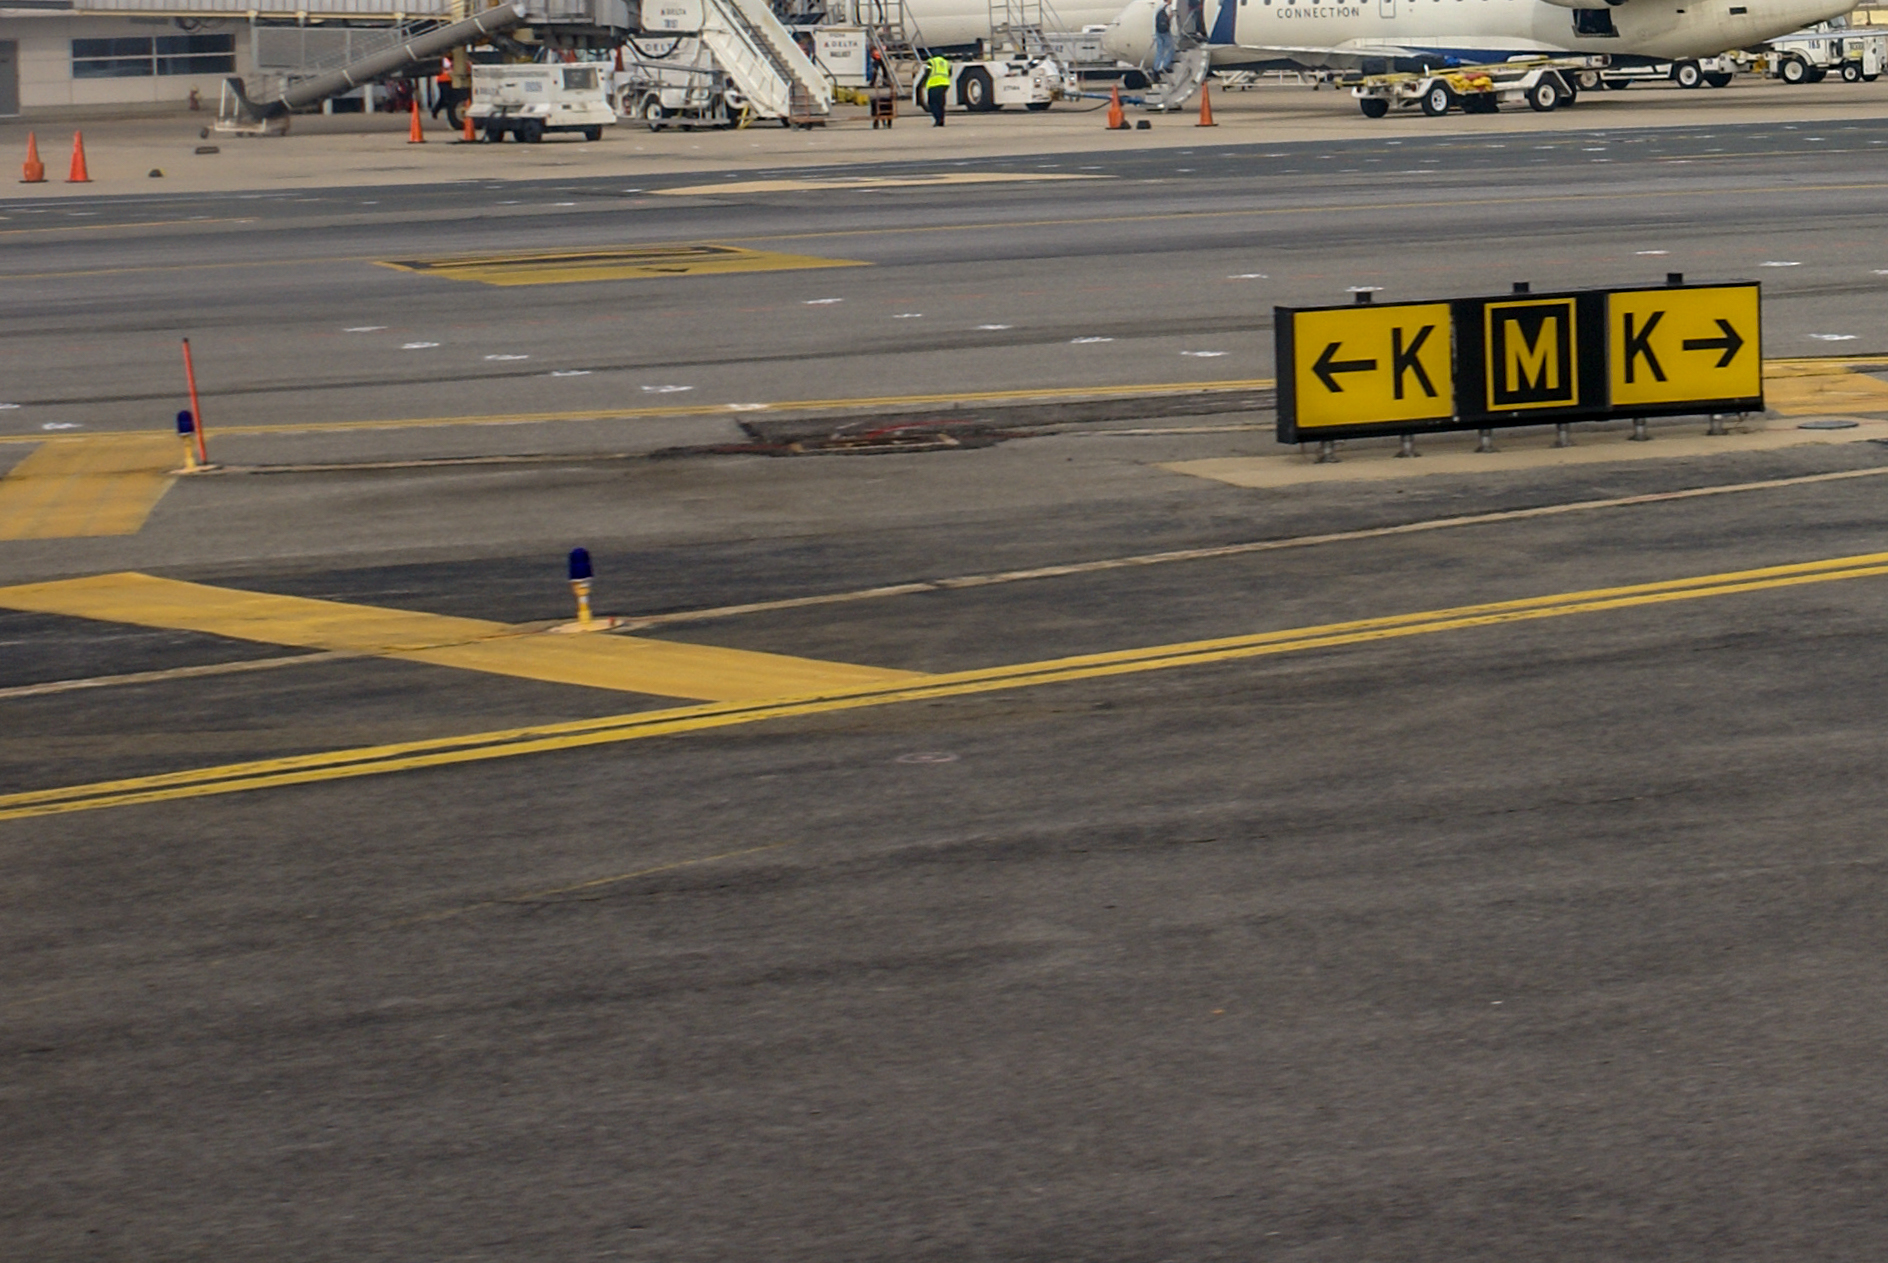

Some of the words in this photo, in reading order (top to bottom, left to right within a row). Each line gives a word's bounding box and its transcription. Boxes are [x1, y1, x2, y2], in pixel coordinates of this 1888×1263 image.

[1276, 7, 1360, 18] CONNECTION
[644, 43, 676, 52] DELT
[831, 40, 858, 48] DELTA
[1391, 325, 1439, 400] K
[1504, 316, 1559, 393] M
[1622, 311, 1667, 384] K
